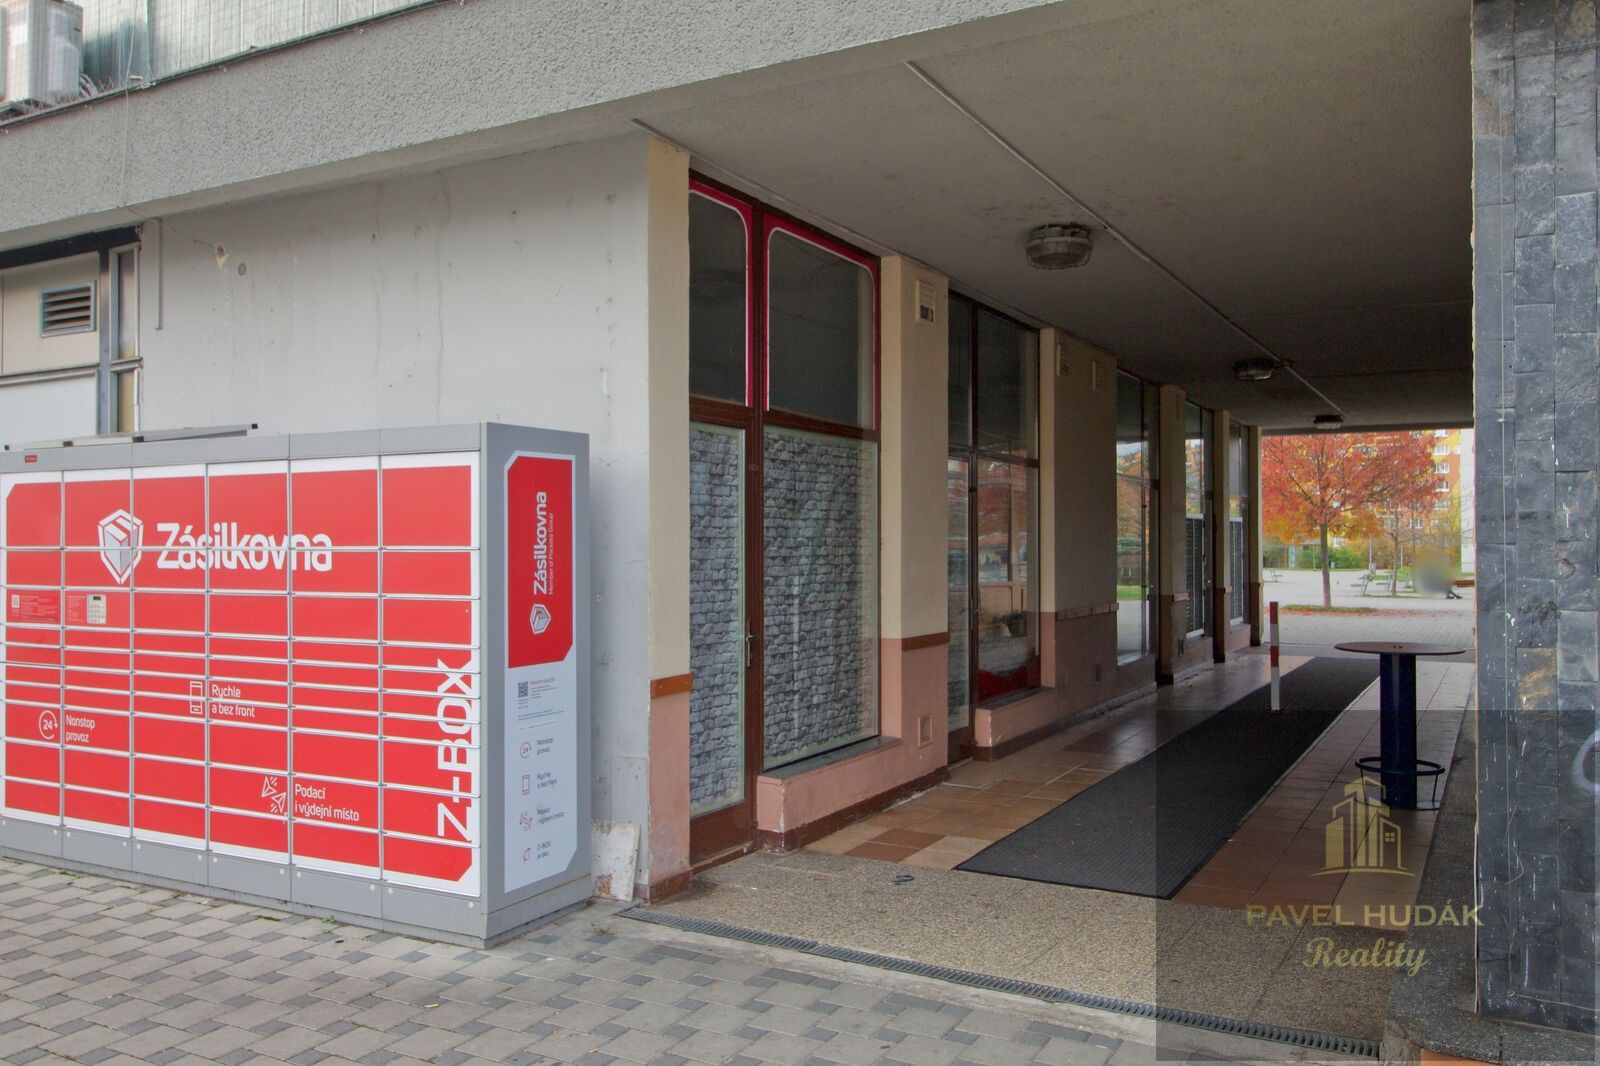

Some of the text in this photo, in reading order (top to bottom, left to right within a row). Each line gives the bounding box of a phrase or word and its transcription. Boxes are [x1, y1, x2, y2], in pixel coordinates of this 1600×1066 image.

[156, 522, 333, 572] Zásilkovna
[534, 491, 547, 595] Zásilkovna
[211, 684, 241, 698] Rychle
[211, 704, 255, 717] a bez front
[43, 719, 53, 730] 24
[65, 715, 96, 730] Nonstop
[65, 731, 89, 743] provoz
[437, 658, 472, 842] Z-BOX
[294, 801, 298, 813] i
[333, 807, 360, 822] místo
